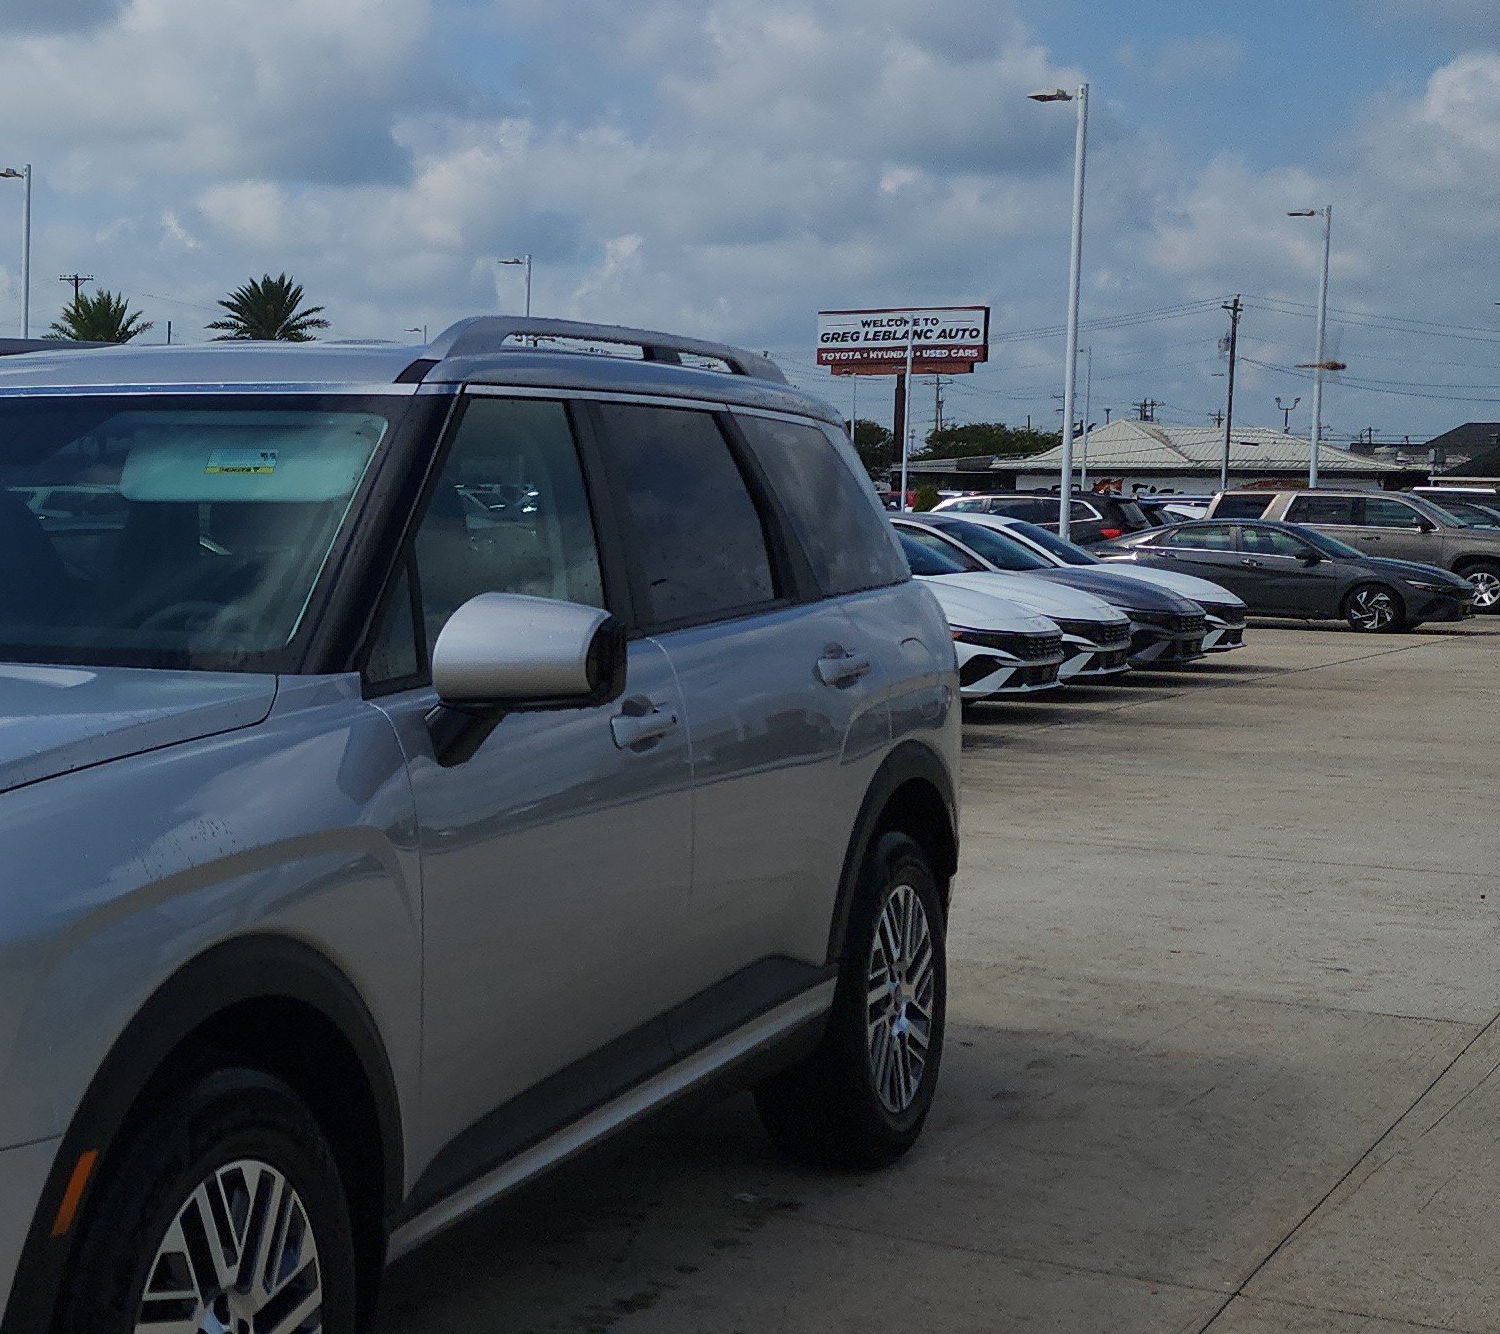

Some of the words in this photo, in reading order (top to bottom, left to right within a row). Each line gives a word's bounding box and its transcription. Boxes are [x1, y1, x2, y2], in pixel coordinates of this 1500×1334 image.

[923, 317, 940, 327] TO
[820, 331, 860, 343] GREG
[863, 328, 934, 342] LEBLANC
[936, 328, 981, 340] AUTO
[821, 351, 862, 361] TOYOTA
[922, 349, 949, 358] USED
[950, 349, 979, 358] CARS
